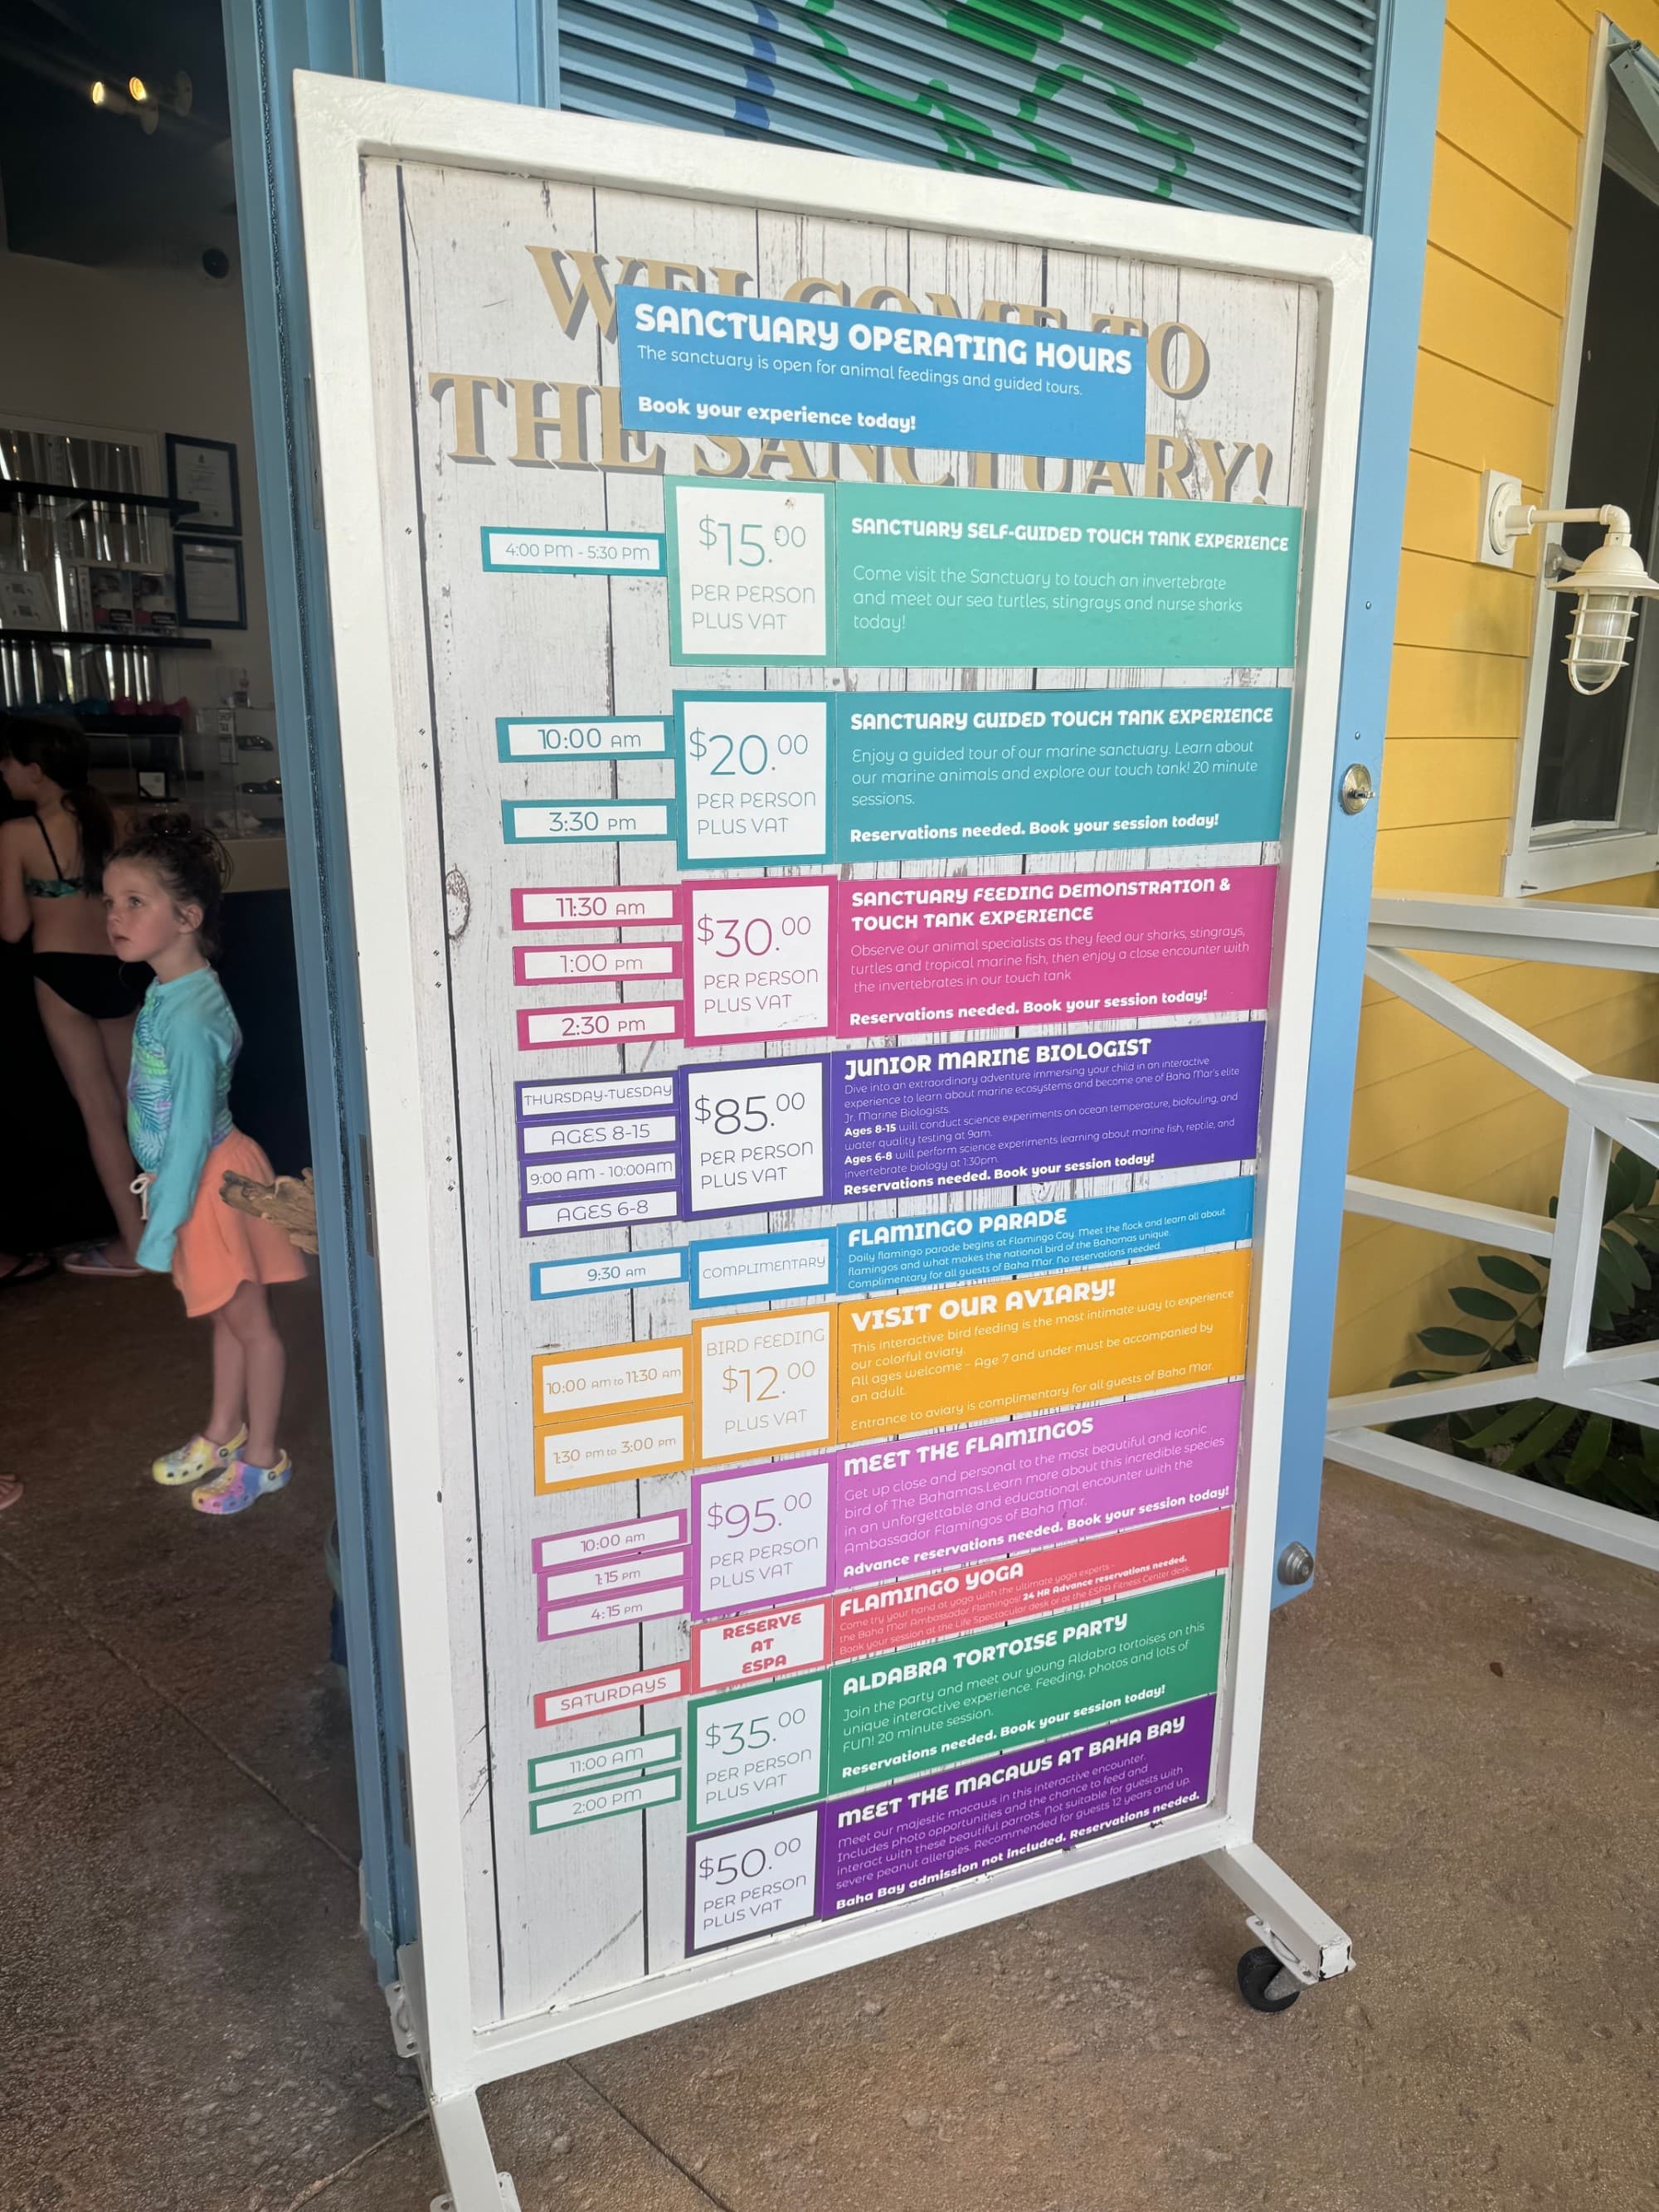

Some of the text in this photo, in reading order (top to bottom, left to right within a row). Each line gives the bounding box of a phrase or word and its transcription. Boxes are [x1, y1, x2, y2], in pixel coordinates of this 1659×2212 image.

[635, 304, 1131, 374] SANCTUARY OPERATING HOURS
[637, 345, 1082, 395] The sanctuary is open for animal feedings and guided tours.
[639, 396, 916, 433] Book your experience today!
[852, 518, 1288, 551] SANCTUARY SELF-GUIDED TOUCH TANK EXPERIENCE
[505, 543, 539, 557] 4:00
[588, 546, 617, 559] 5:30
[854, 566, 1226, 590] Come visit the Sanctuary to touch an invertebrate
[691, 584, 815, 604] PER PERSON
[693, 612, 787, 630] PLUS VAT
[851, 707, 1272, 731] SANCTUARY GUIDED TOUCH TANK EXPERIENCE
[538, 728, 601, 750] 10:00
[853, 740, 1253, 766] Enjoy a guided tour of our marine sanctuary. Learn about
[851, 814, 1219, 842] Reservations needed. Book your session today!
[852, 878, 1230, 907] SANCTUARY FEEDING DEMONSTRATION &
[852, 907, 1093, 931] TOUCH TANK EXPERIENCE
[851, 927, 1244, 956] Observe our animal specialists as they feed our sharks, stingrays,
[844, 1038, 1151, 1080] JUNIOR MARINE BIOLOGIST
[523, 1084, 673, 1107] THURSDAY-TUESDAY
[844, 1106, 950, 1123] Jr. Marine Biologists.
[551, 1123, 651, 1146] AGES 8-15
[557, 1200, 649, 1223] AGES 6-8
[849, 1208, 1067, 1247] FLAMINGO PARADE
[587, 1266, 620, 1282] 9:30
[703, 1257, 826, 1280] COMPLIMENTARY
[851, 1279, 1115, 1331] VISIT OUR AVIARY!
[706, 1329, 825, 1356] BIRD FEEDING
[851, 1347, 966, 1370] our colorful aviary.
[724, 1409, 807, 1434] PLUS VAT
[844, 1417, 1093, 1476] MEET THE FLAMINGOS
[581, 1534, 620, 1553] 10:00
[840, 1563, 1023, 1616] FLAMINGO YOGA
[722, 1612, 802, 1641] RESERVE
[750, 1638, 775, 1653] AT
[844, 1613, 1127, 1695] ALDABRA TORTOISE PARTY
[742, 1654, 787, 1675] ESPA
[561, 1677, 667, 1711] SATURDAYS
[844, 1709, 993, 1752] FUN! 20 minute session.
[570, 1754, 607, 1774] 11:00
[839, 1716, 1185, 1828] MEET THE MACAWS AT BAHA BAY
[836, 1791, 1202, 1909] Baha Bay admission not included. Reservations needed.
